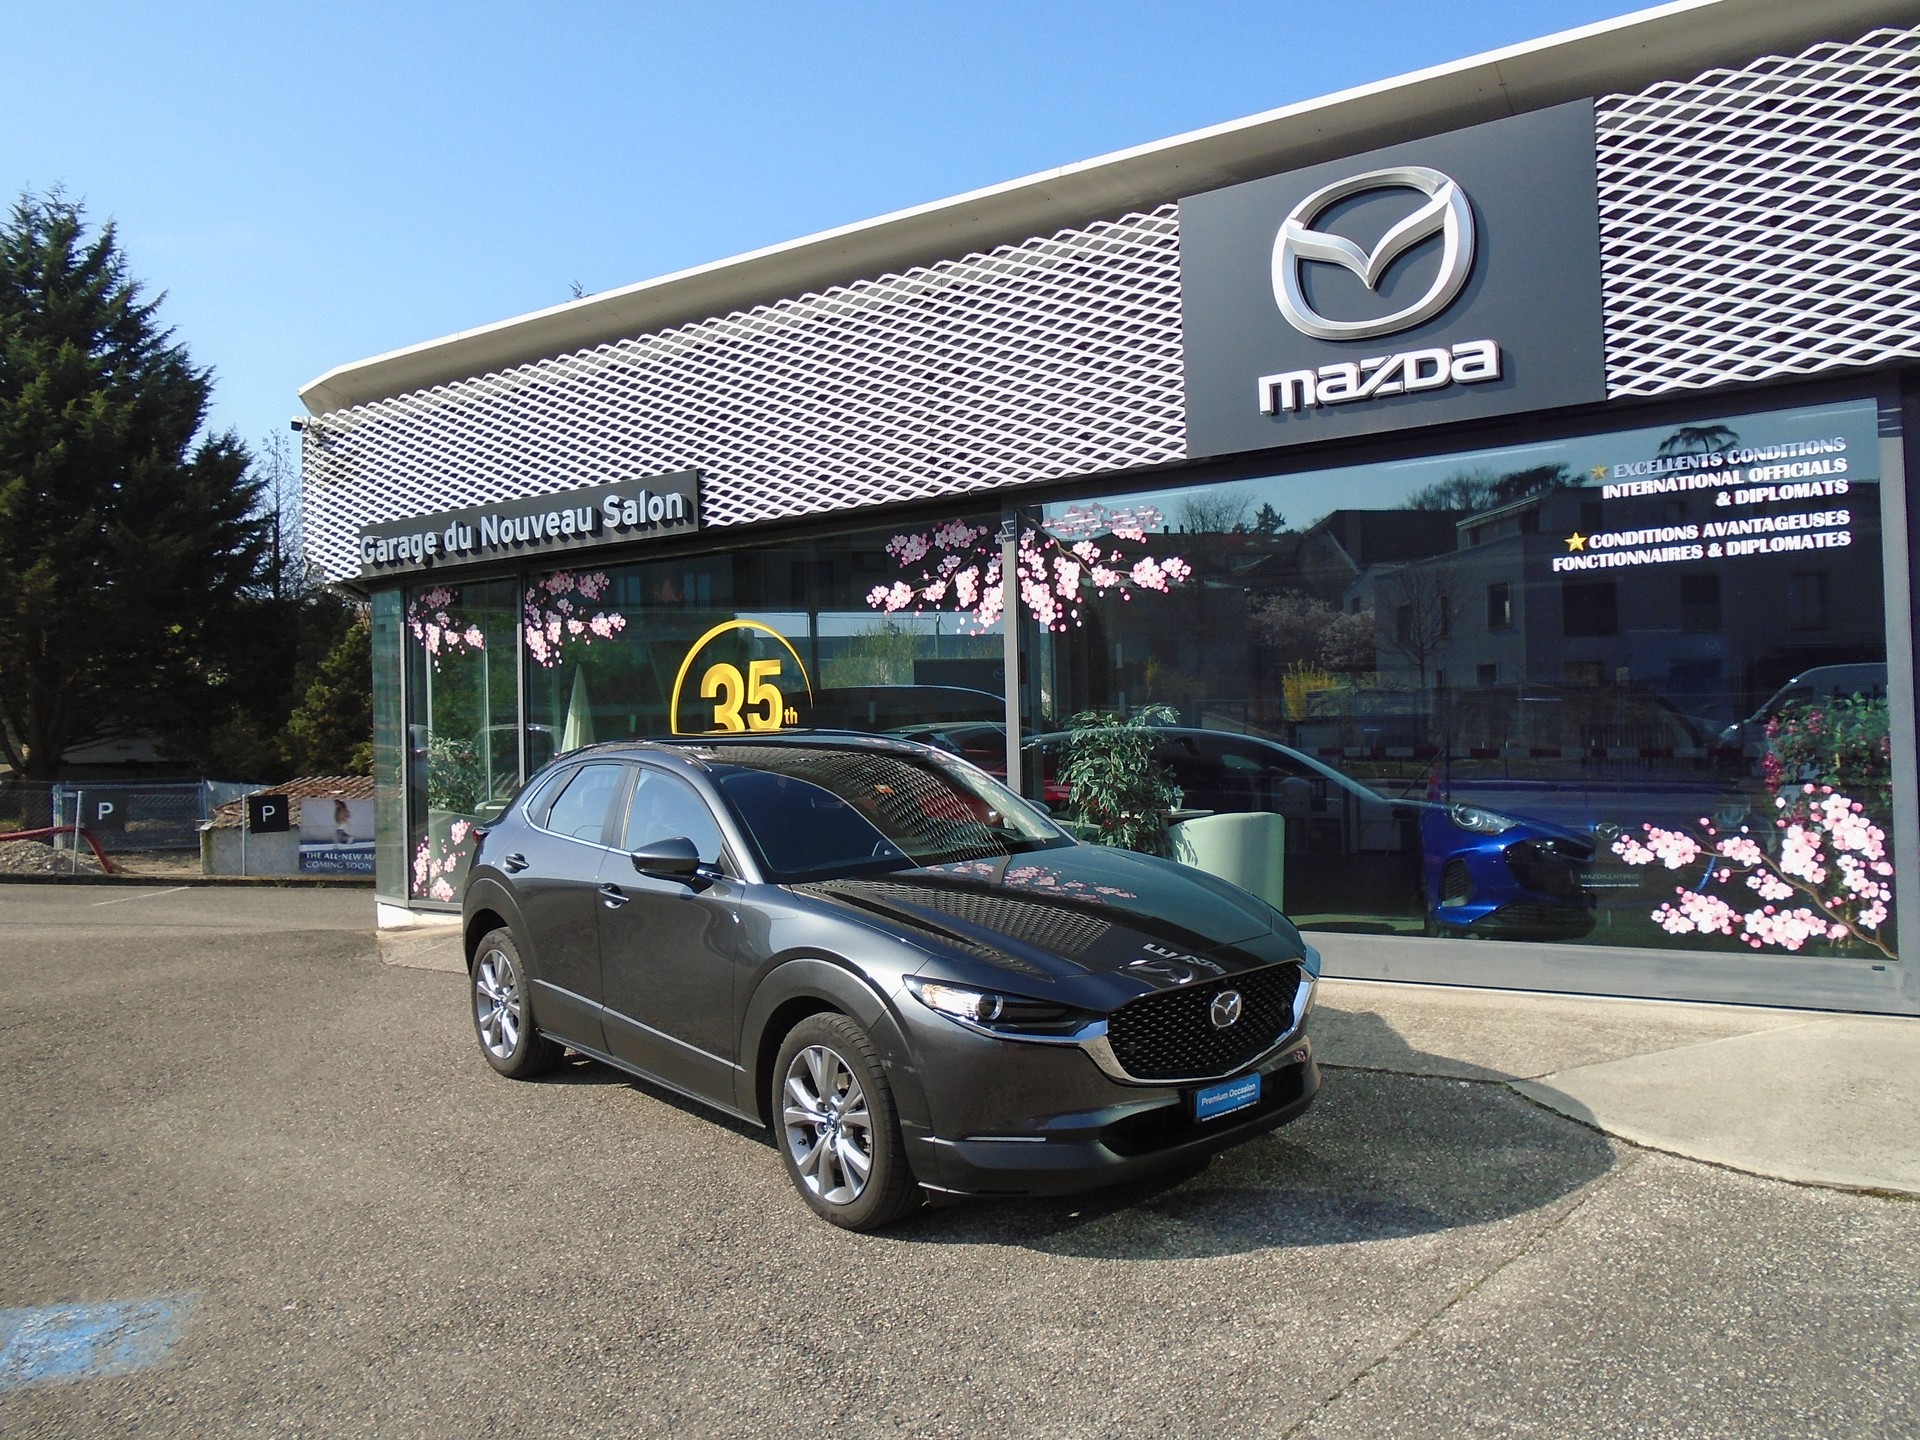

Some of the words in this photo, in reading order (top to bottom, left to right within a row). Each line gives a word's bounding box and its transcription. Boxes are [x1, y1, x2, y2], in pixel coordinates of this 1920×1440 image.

[1258, 339, 1500, 415] mazda
[1602, 472, 1744, 500] INTERNATIONAL
[1749, 457, 1848, 483] OFFICIALS
[1613, 452, 1723, 479] EXCELLENTS
[1727, 437, 1847, 465] CONDITIONS
[1715, 491, 1731, 507] &
[1735, 478, 1849, 505] DIPLOMATS
[360, 532, 437, 565] Garage
[444, 521, 472, 552] du
[481, 506, 595, 547] Nouveau
[603, 489, 684, 528] Salon
[1589, 524, 1699, 550] CONDITIONS
[1702, 509, 1850, 539] AVANTAGEUSES
[1552, 544, 1703, 573] FONCTIONNAIRES
[1707, 542, 1723, 559] &
[1726, 531, 1851, 557] DIPLOMATES
[98, 802, 114, 820] P
[262, 805, 276, 823] P
[346, 862, 372, 870] SOON
[1202, 1091, 1229, 1106] Premium
[1229, 1083, 1256, 1097] Occasion
